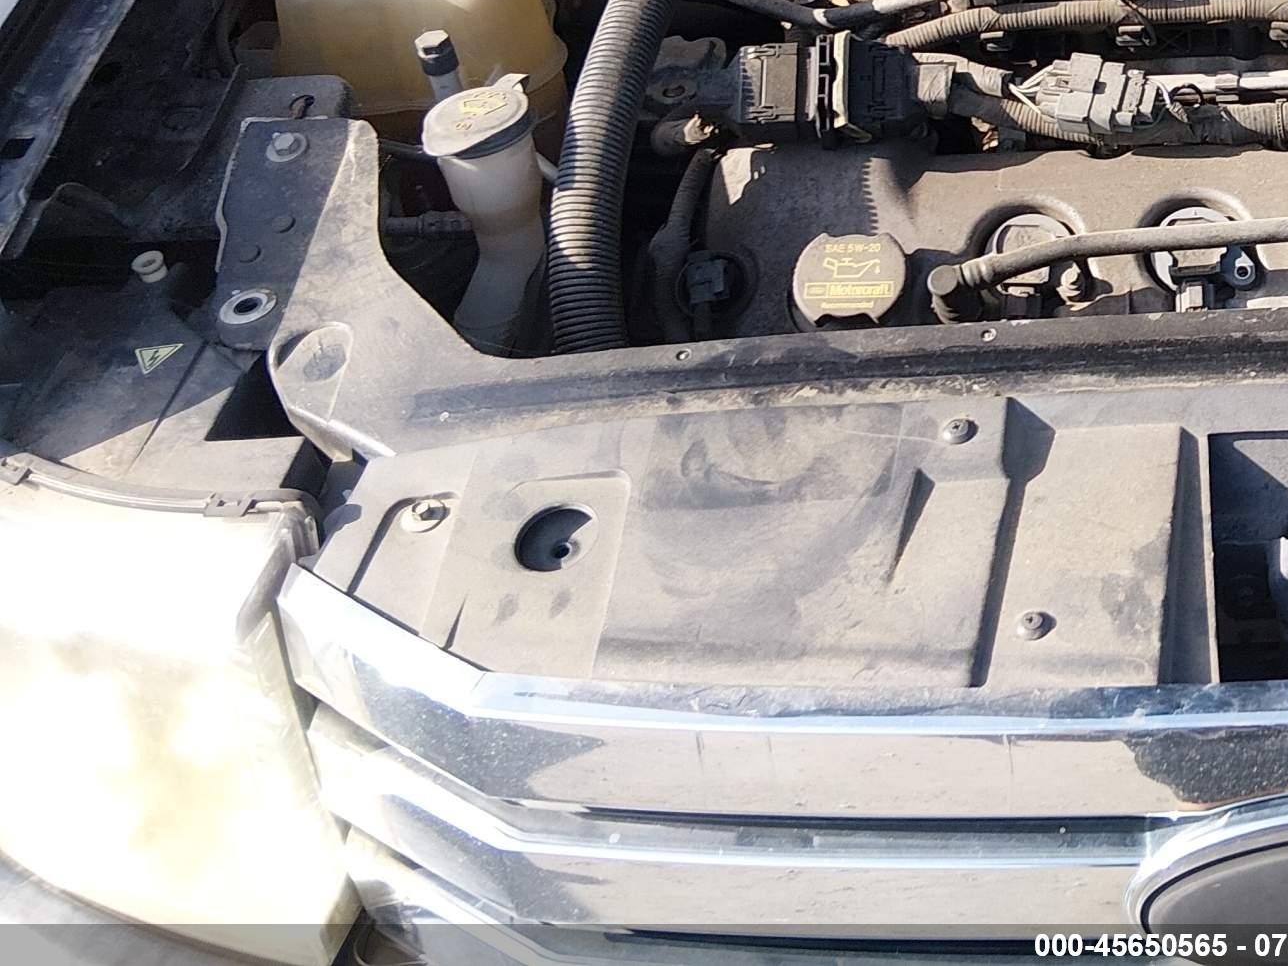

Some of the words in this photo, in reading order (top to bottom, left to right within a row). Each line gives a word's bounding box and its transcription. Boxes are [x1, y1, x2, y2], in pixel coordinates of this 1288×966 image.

[824, 244, 845, 253] SAE
[847, 243, 881, 253] 5W-20
[829, 284, 891, 296] Motorcraft
